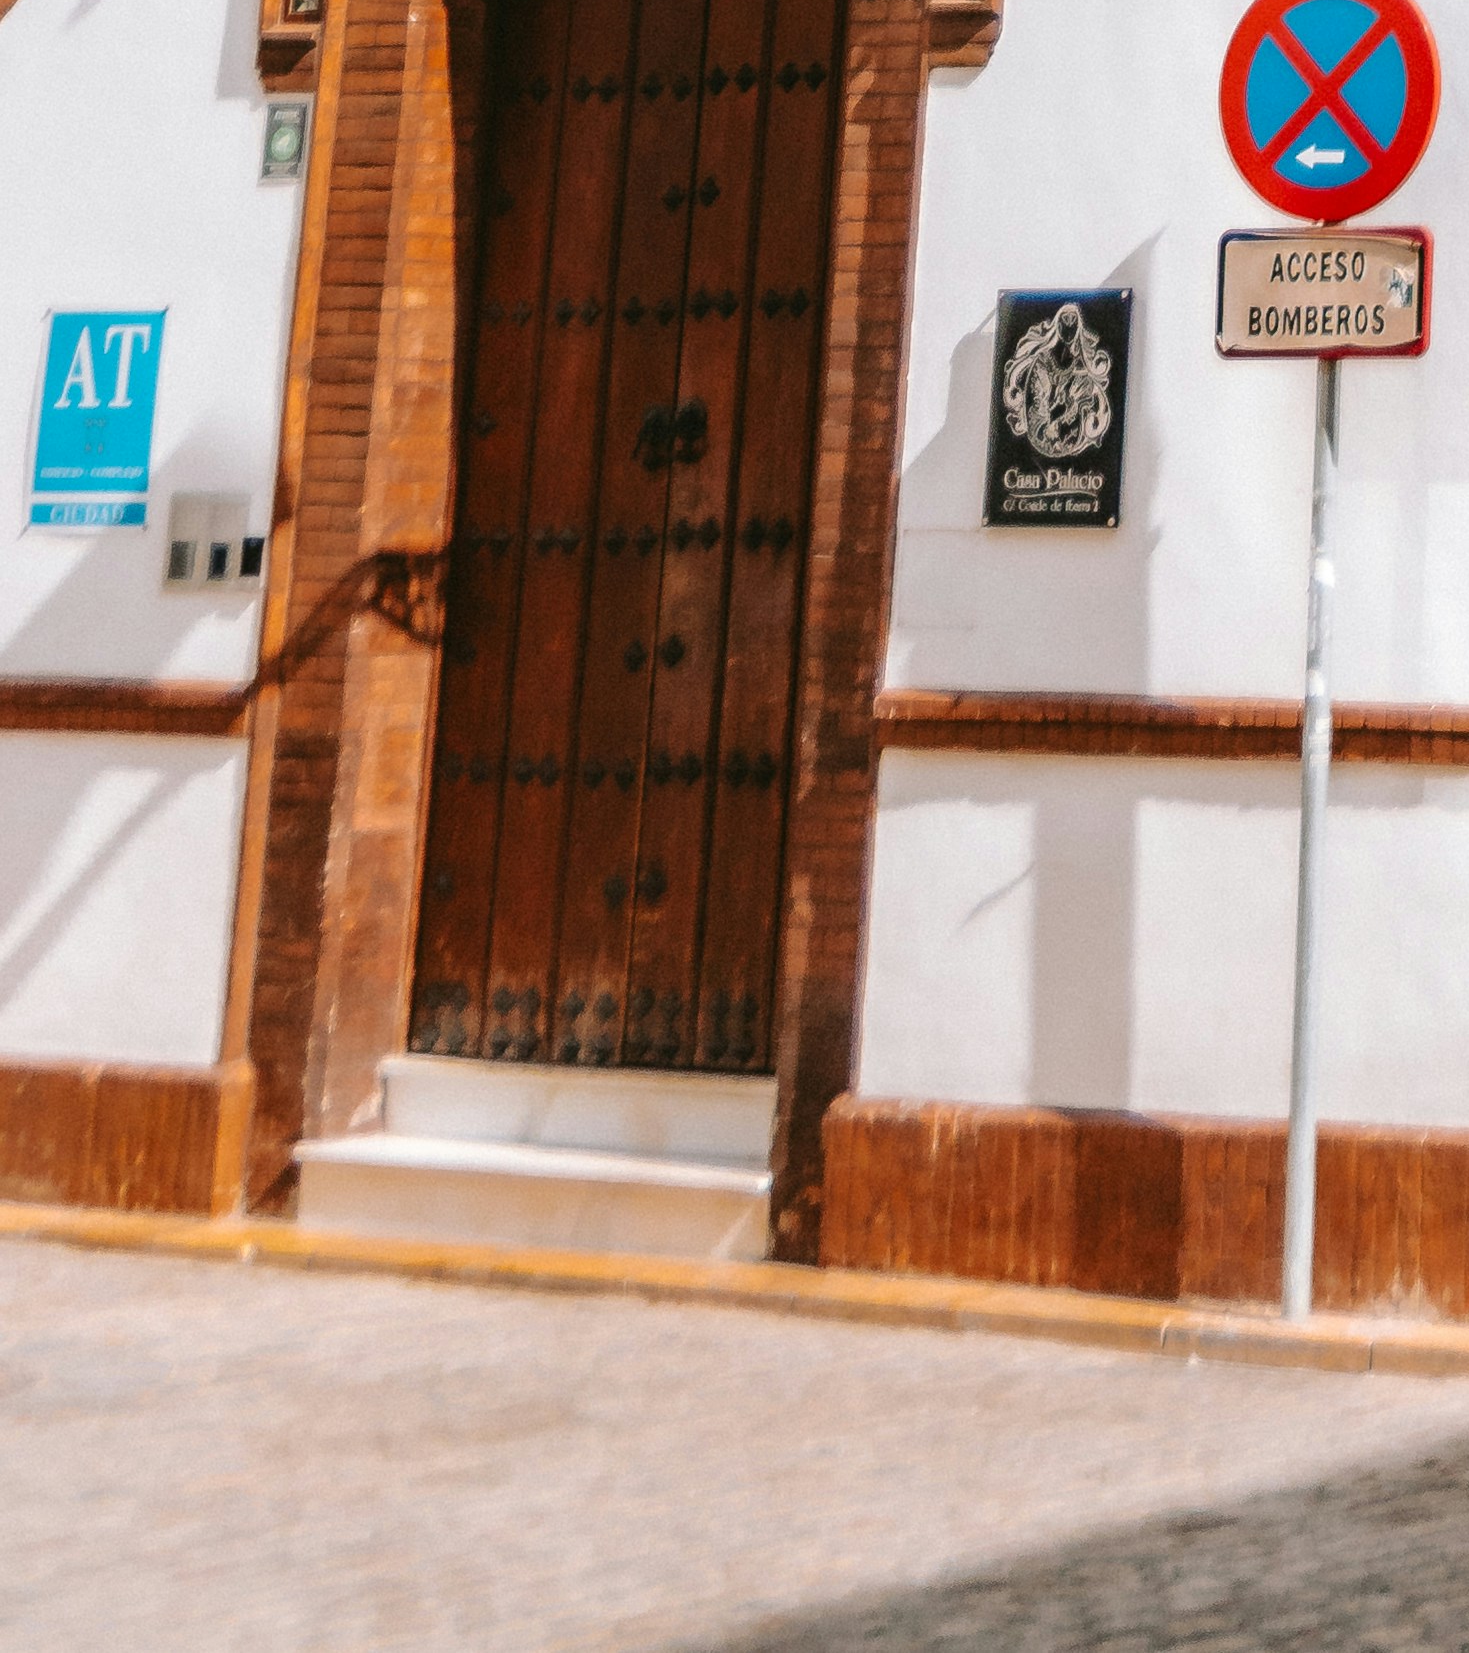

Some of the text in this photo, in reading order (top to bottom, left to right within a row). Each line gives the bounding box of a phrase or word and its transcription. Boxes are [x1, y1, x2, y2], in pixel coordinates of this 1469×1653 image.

[1270, 250, 1366, 283] ACCESO
[1247, 304, 1386, 337] BOMBEROS
[54, 323, 151, 410] AT
[1003, 467, 1105, 490] Casa Palacio
